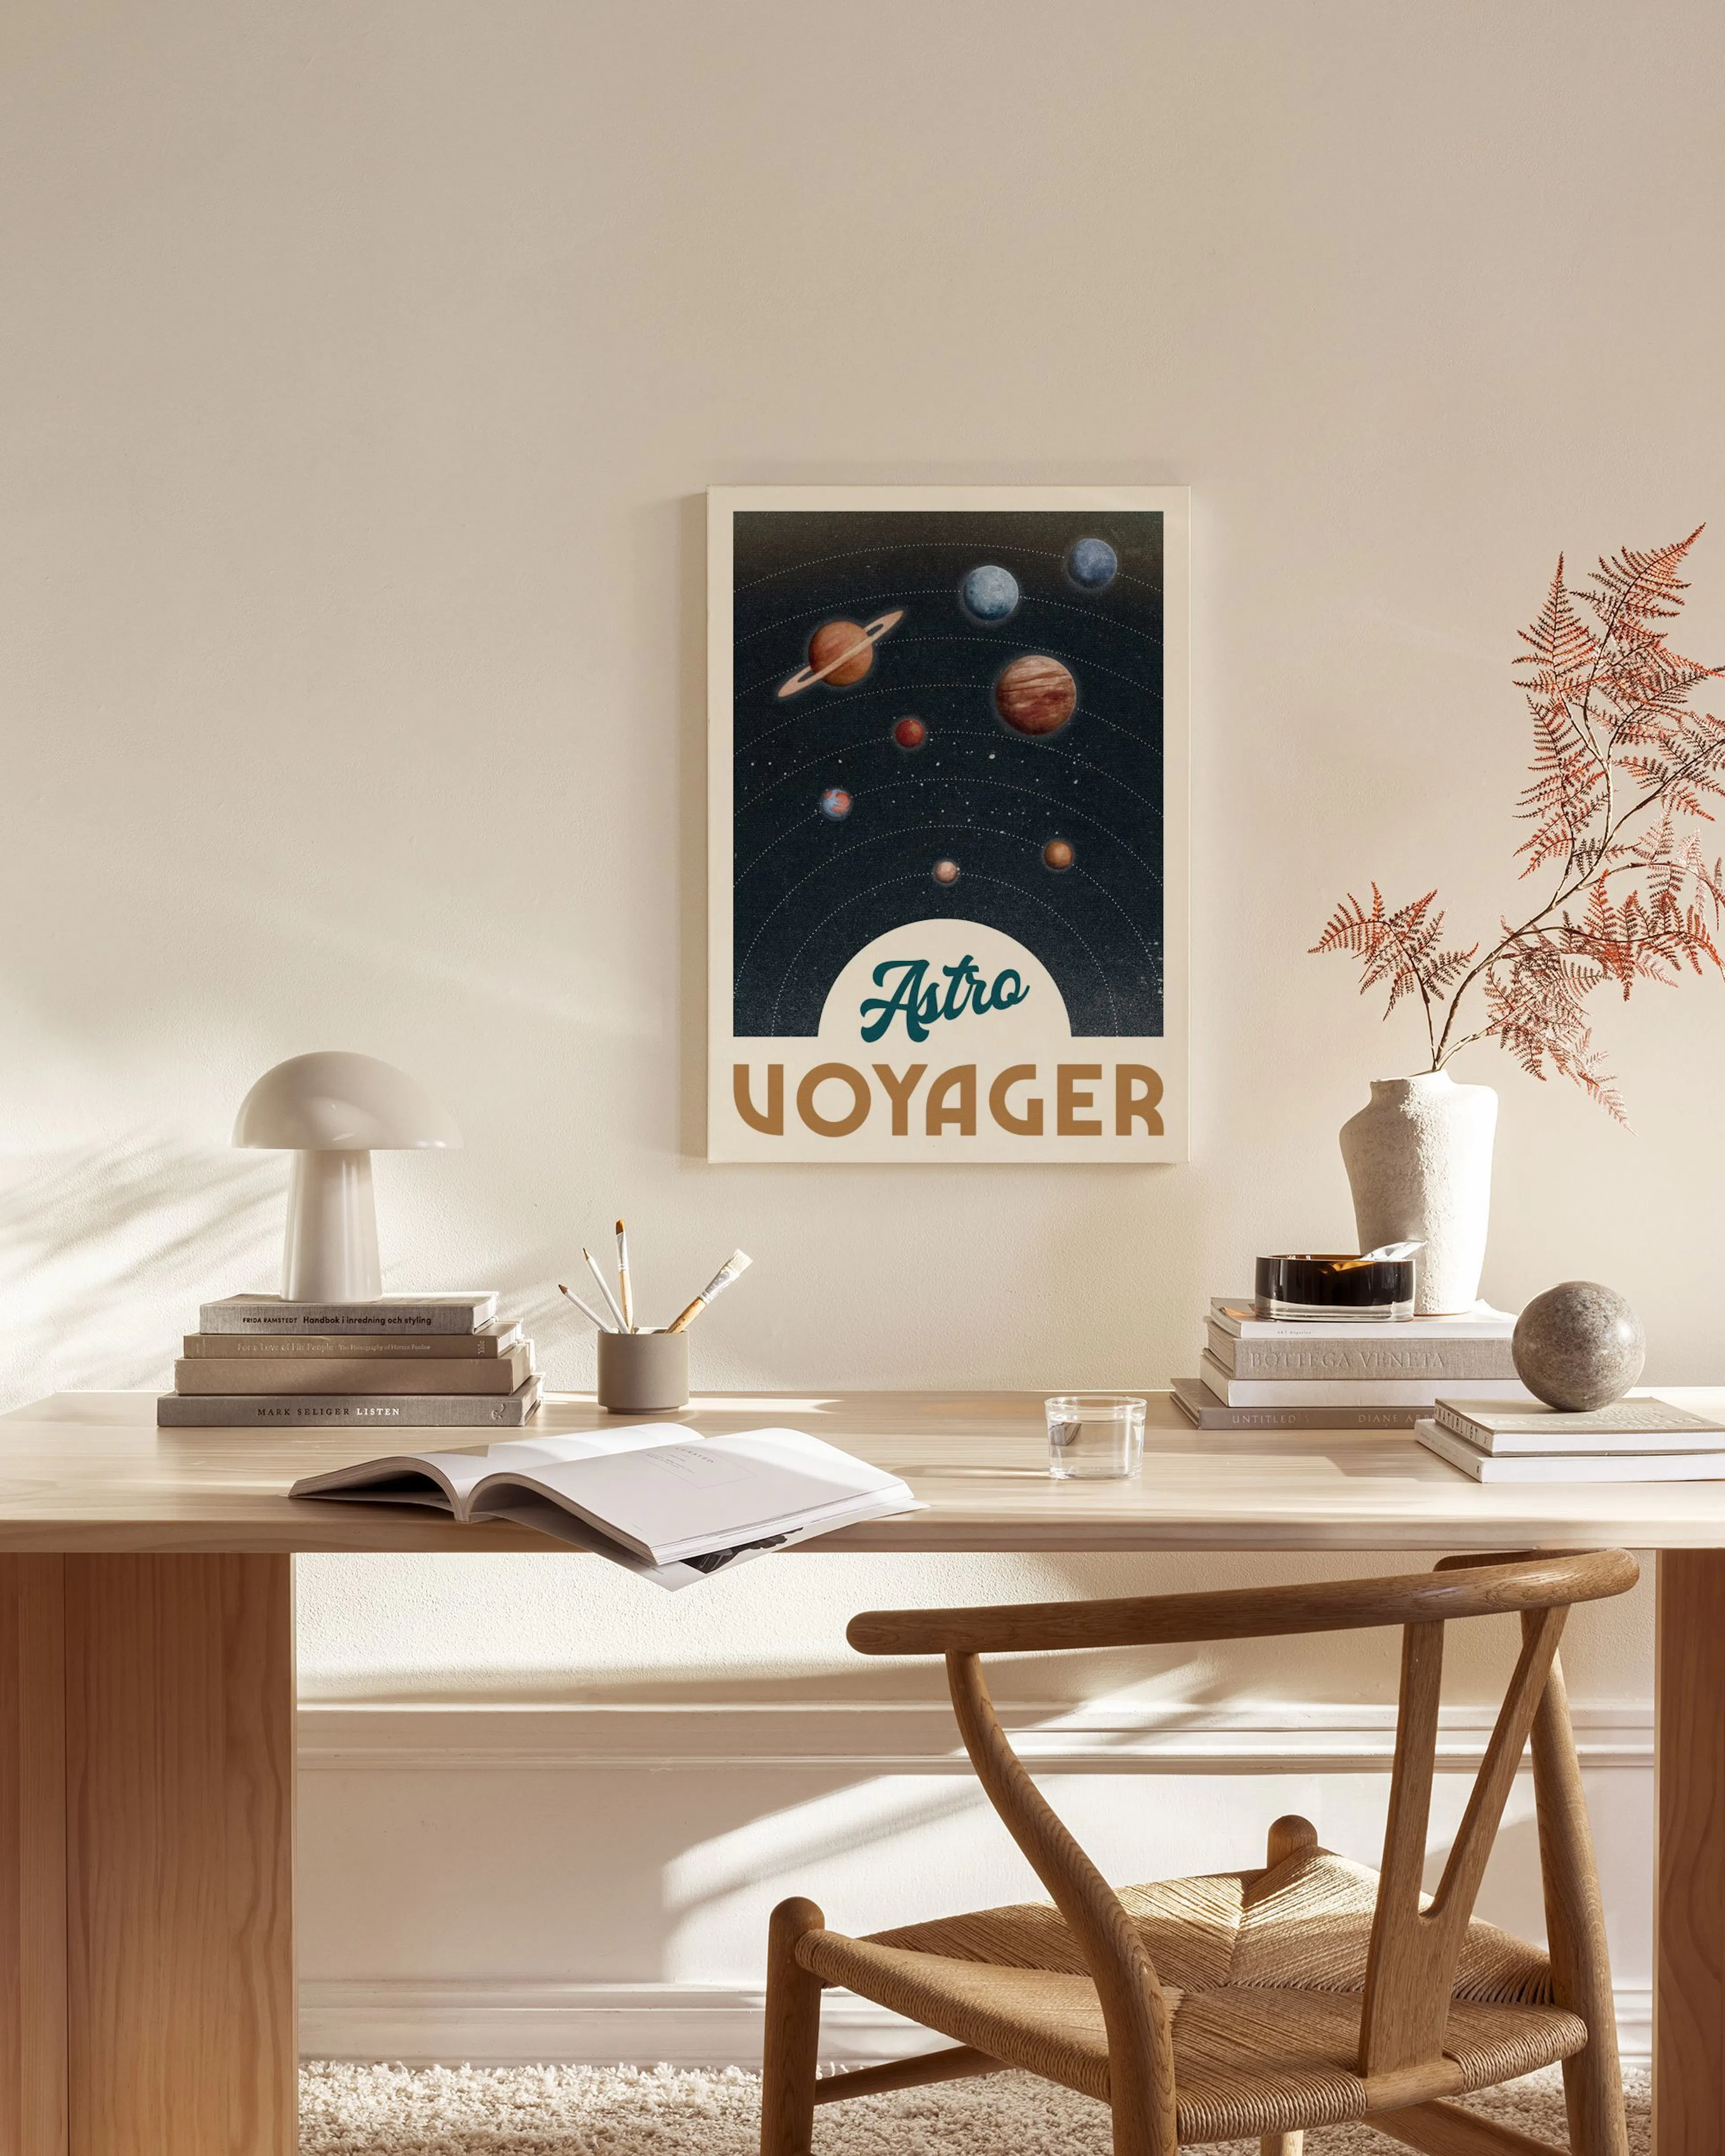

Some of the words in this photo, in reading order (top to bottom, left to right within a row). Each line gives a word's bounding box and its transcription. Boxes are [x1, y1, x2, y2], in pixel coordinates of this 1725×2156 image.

[860, 954, 1030, 1043] Astro
[733, 1062, 1164, 1137] VOYAGER
[303, 1316, 340, 1324] Handbok
[346, 1316, 385, 1325] inredning
[404, 1316, 432, 1325] styling
[1250, 1352, 1351, 1368] BOTTEGA
[1359, 1352, 1445, 1368] VENETA
[1232, 1414, 1296, 1423] UNTITLED
[1358, 1414, 1398, 1423] DIANE
